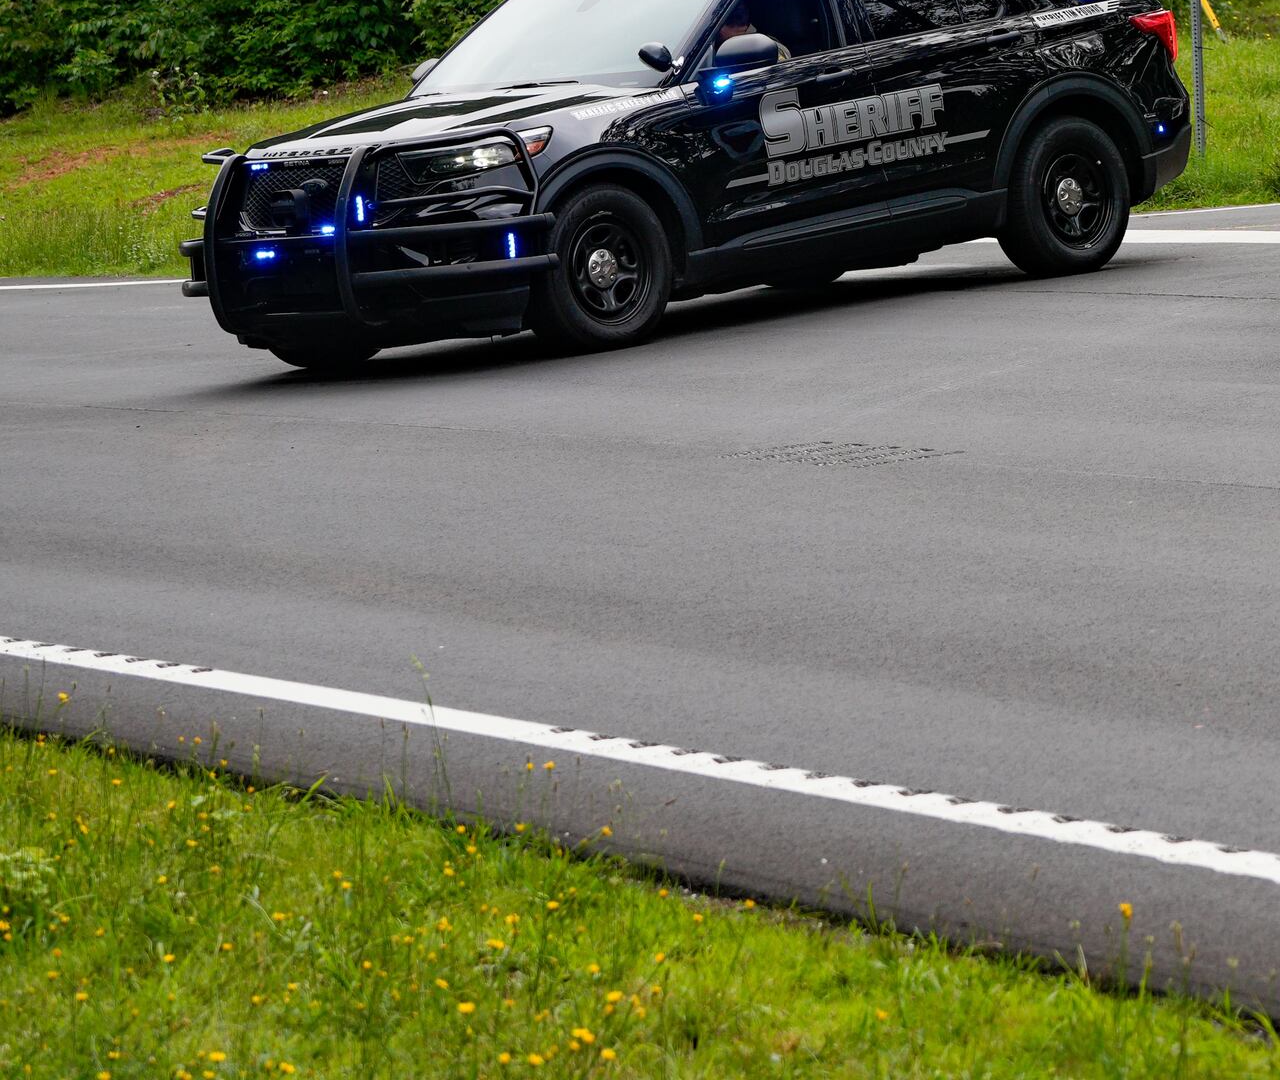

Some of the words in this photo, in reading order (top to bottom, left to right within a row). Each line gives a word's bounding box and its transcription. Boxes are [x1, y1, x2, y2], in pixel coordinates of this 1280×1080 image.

[570, 103, 618, 120] TRAFFIC
[616, 95, 653, 112] SAFETY
[653, 88, 680, 104] UNIT
[759, 83, 945, 159] SHERIFF
[767, 150, 865, 186] DOUGLAS
[867, 131, 948, 166] COUNTY
